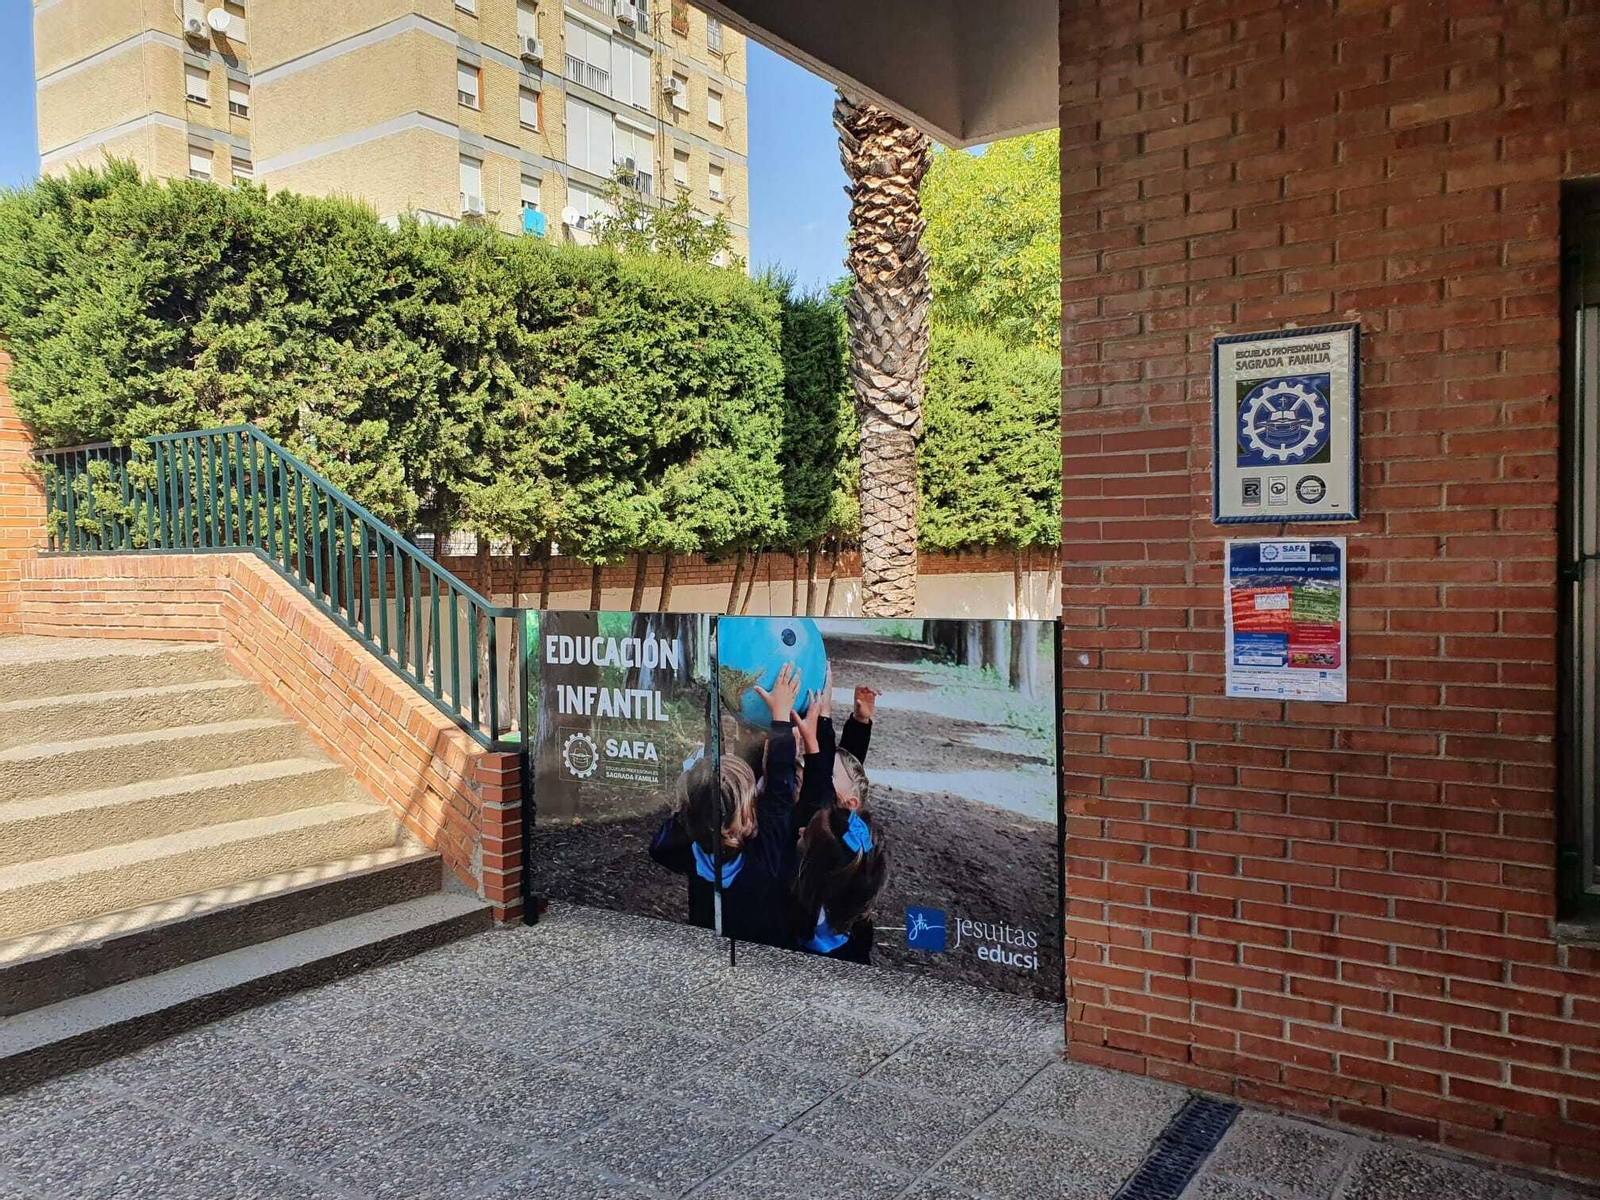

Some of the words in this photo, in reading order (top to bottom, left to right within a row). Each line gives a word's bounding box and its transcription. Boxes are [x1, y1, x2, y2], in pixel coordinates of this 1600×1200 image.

[1235, 347, 1271, 359] ESCUELAS
[1272, 342, 1331, 356] PROFESIONALES
[1235, 357, 1284, 371] SAGRADA
[1288, 353, 1331, 366] FAMILIA
[546, 632, 679, 670] EDUCACIÓN
[557, 685, 669, 721] INFANTIL
[605, 738, 658, 761] SAFA
[605, 771, 634, 780] SAGRADA
[635, 774, 659, 783] FAMILIA
[953, 917, 1038, 949] Jesuitas
[977, 945, 1038, 970] educsi
